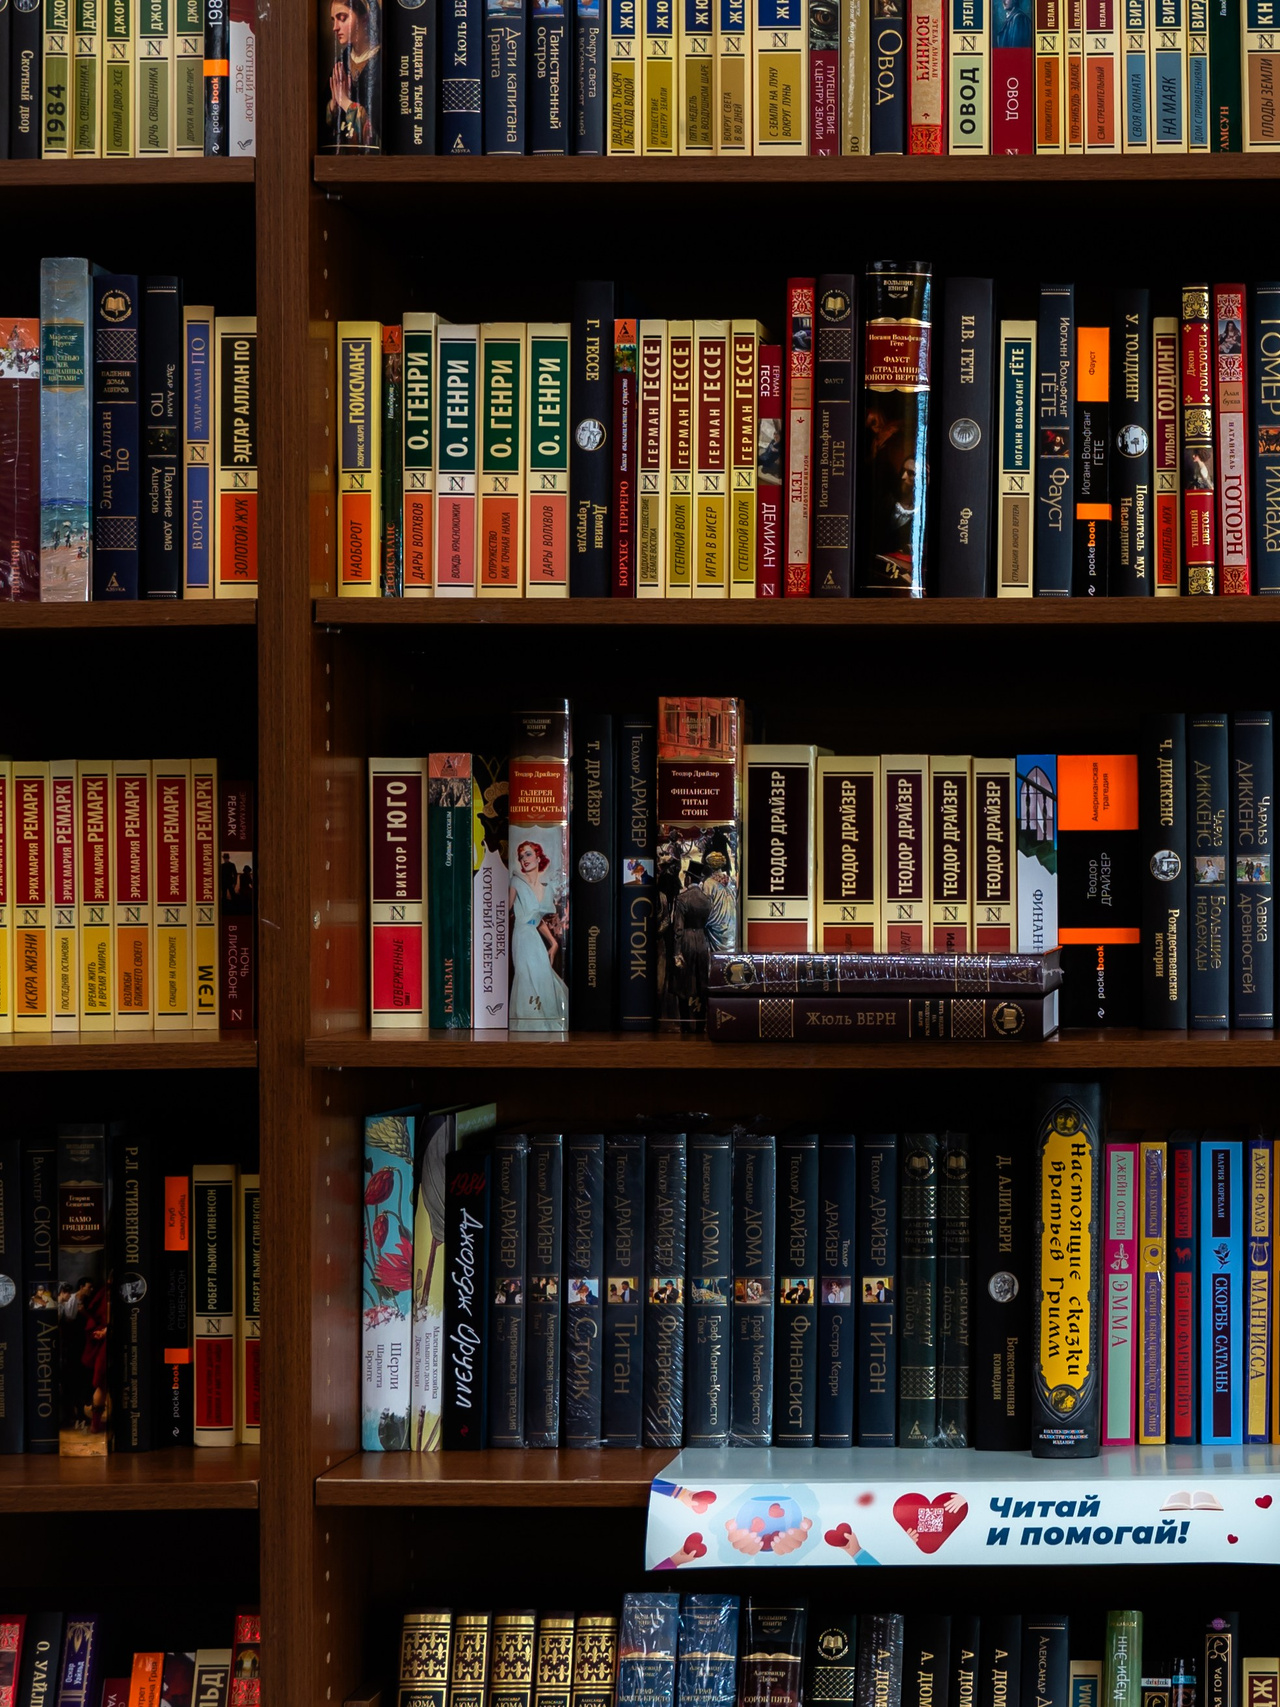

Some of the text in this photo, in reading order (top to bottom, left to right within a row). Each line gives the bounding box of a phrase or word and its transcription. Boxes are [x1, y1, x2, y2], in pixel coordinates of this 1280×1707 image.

[235, 65, 243, 93] ЭССЕ
[491, 28, 501, 78] Гранта
[549, 25, 564, 130] Таинственный
[917, 15, 929, 82] ВОЙНИЧ
[47, 84, 66, 145] 1984
[504, 26, 522, 142] Дети капитана
[815, 68, 823, 104] ЦЕНТРУ
[827, 66, 835, 135] ПУТЕШЕСТВИЕ
[959, 67, 980, 135] ОВОД
[1006, 77, 1018, 120] ОВОД
[1162, 76, 1177, 136] НА МАЯК
[1262, 58, 1273, 137] ПЛОДЫ ЗЕМЛИ
[815, 106, 823, 140] ЗЕМЛИ
[233, 340, 253, 463] ЭДГАР АЛЛАН ПО
[348, 342, 366, 425] ГЮИСМАНС
[407, 351, 429, 451] О. ГЕНРИ
[538, 357, 561, 457] О. ГЕНРИ
[672, 345, 689, 463] ГЕРМАН ГЕССЕ
[1040, 371, 1057, 418] ГЁТЕ
[1158, 341, 1175, 464] УИЛЬЯМ ГОЛДИНГ
[192, 500, 203, 550] ВОРОН
[231, 498, 249, 577] ЗОЛОТОЙ ЖУК
[351, 520, 363, 577] НАОБОРОТ
[675, 505, 685, 574] СТЕПНОЙ ВОЛК
[707, 506, 715, 540] БИСЕР
[760, 502, 776, 568] ДЕМИАН
[958, 507, 973, 545] Фауст
[1223, 474, 1244, 557] ГОТОРН
[705, 556, 715, 577] ИГРА
[23, 783, 39, 840] РЕМАРК
[386, 781, 408, 897] ВИКТОР ГЮГО
[768, 770, 788, 893] ТЕОДОР ДРАЙЗЕР
[1240, 893, 1256, 995] древностей
[1256, 893, 1272, 943] Лавка
[1097, 945, 1105, 998] pocketbook
[859, 1013, 896, 1025] ВЕРН
[208, 1189, 217, 1239] СТИВЕНСОН
[1065, 1142, 1086, 1377] Настоящие сказки
[449, 1208, 484, 1409] Джордж Оруэлл
[1046, 1276, 1065, 1359] Гримм
[1111, 1280, 1128, 1348] ЭММА
[1216, 1277, 1227, 1393] СКОРБЬ САТАНЫ
[1249, 1277, 1268, 1381] МАНТИССА
[986, 1519, 1191, 1549] и помогай!
[988, 1494, 1100, 1518] Читай
[1114, 1635, 1129, 1701] Мэри-Энн
